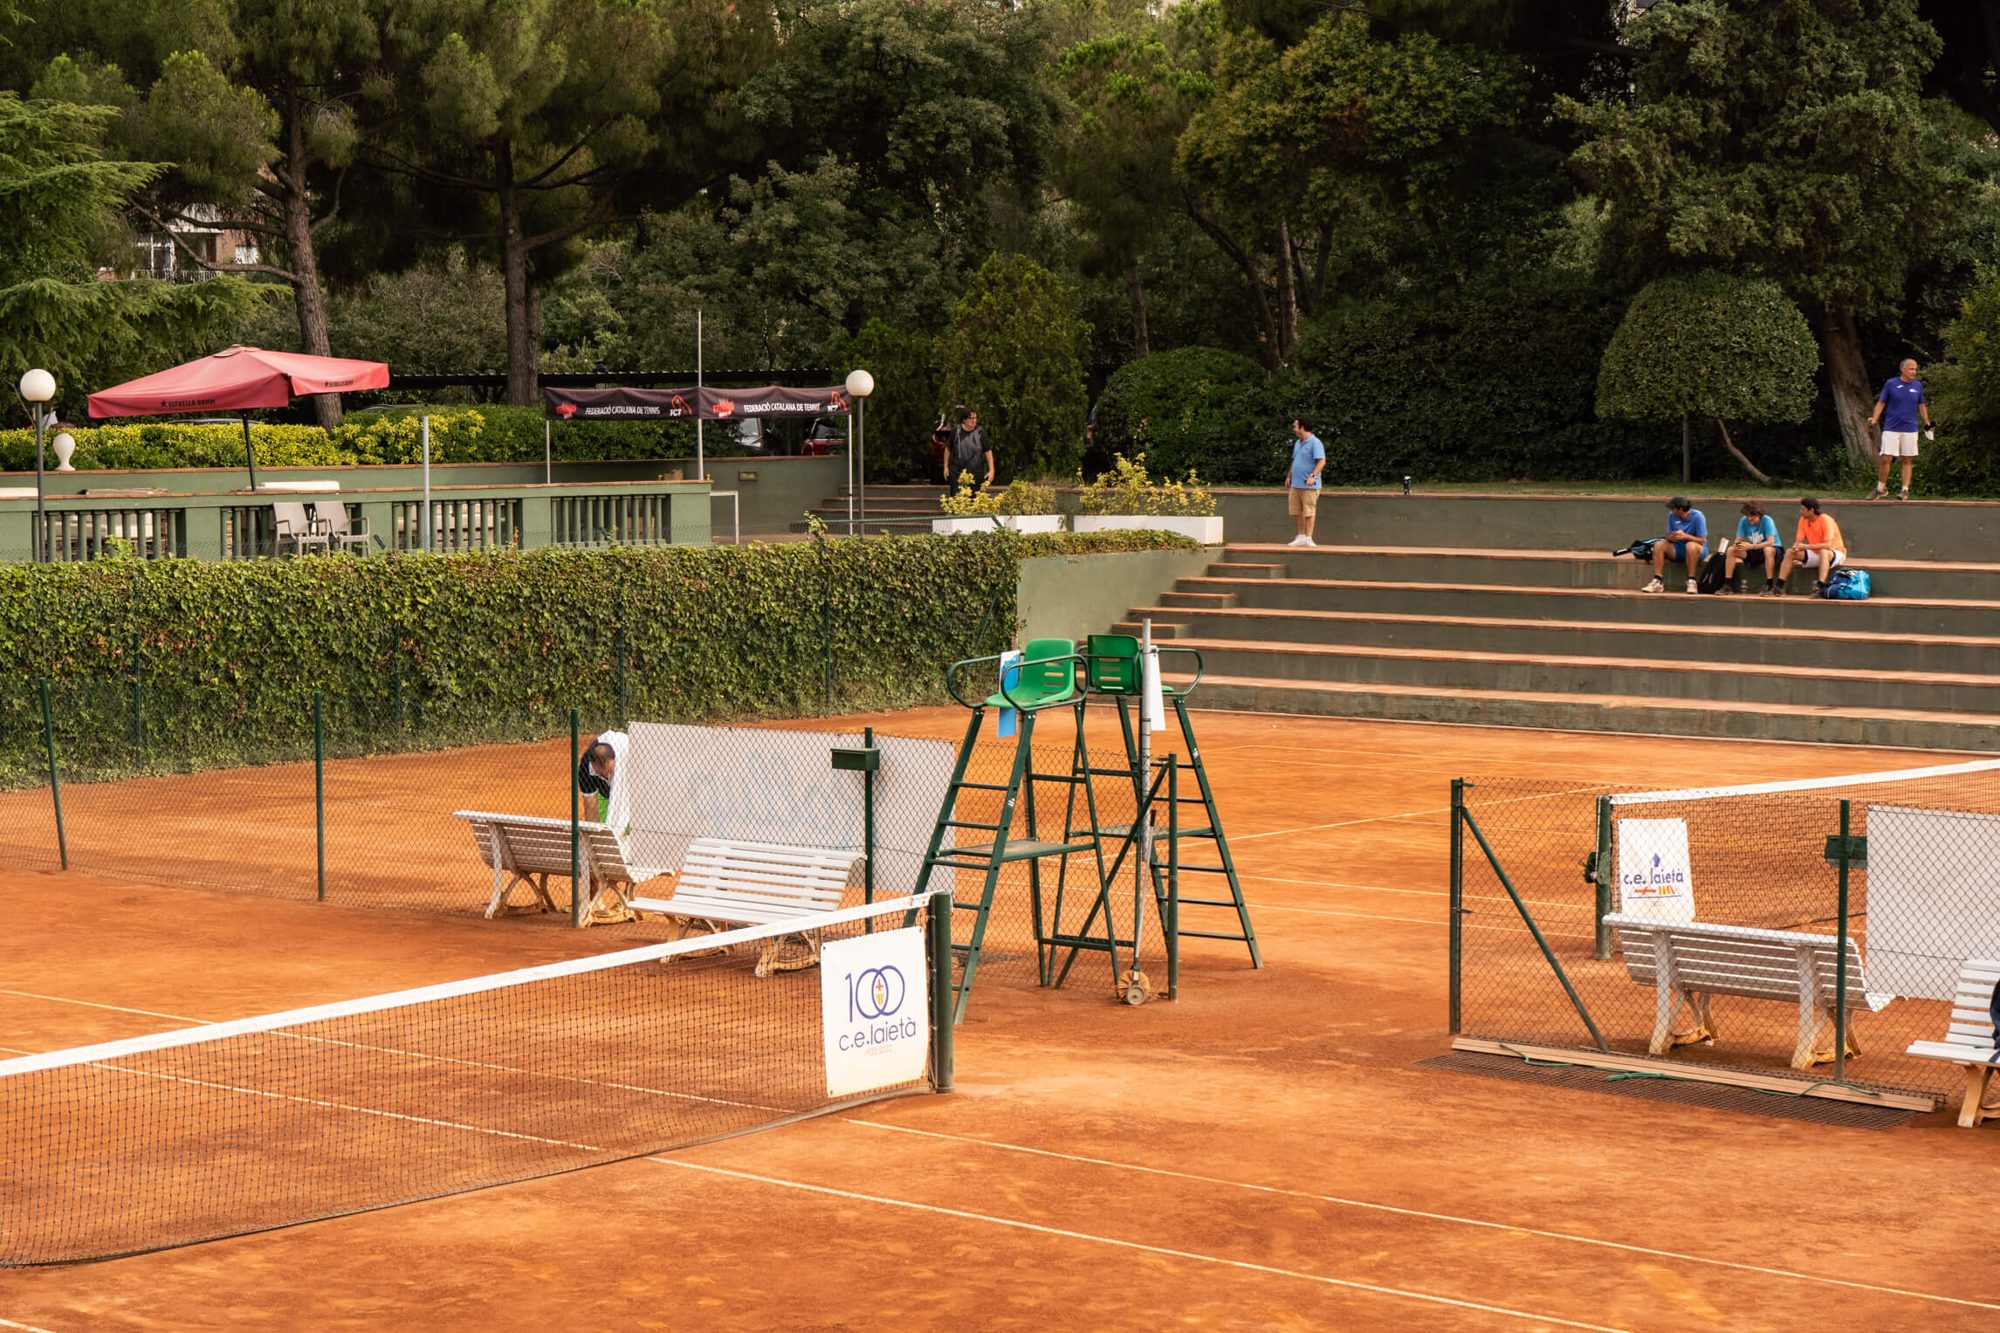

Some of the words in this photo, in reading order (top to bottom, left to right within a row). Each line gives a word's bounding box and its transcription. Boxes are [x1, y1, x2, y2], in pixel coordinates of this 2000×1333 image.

[611, 406, 636, 415] CATALANA
[637, 406, 644, 415] DE
[644, 406, 660, 415] TENNIS
[771, 402, 796, 412] CATALANA
[796, 403, 804, 412] DE
[804, 402, 821, 412] TENNIS
[1650, 868, 1684, 885] laietà
[844, 965, 905, 1023] 100
